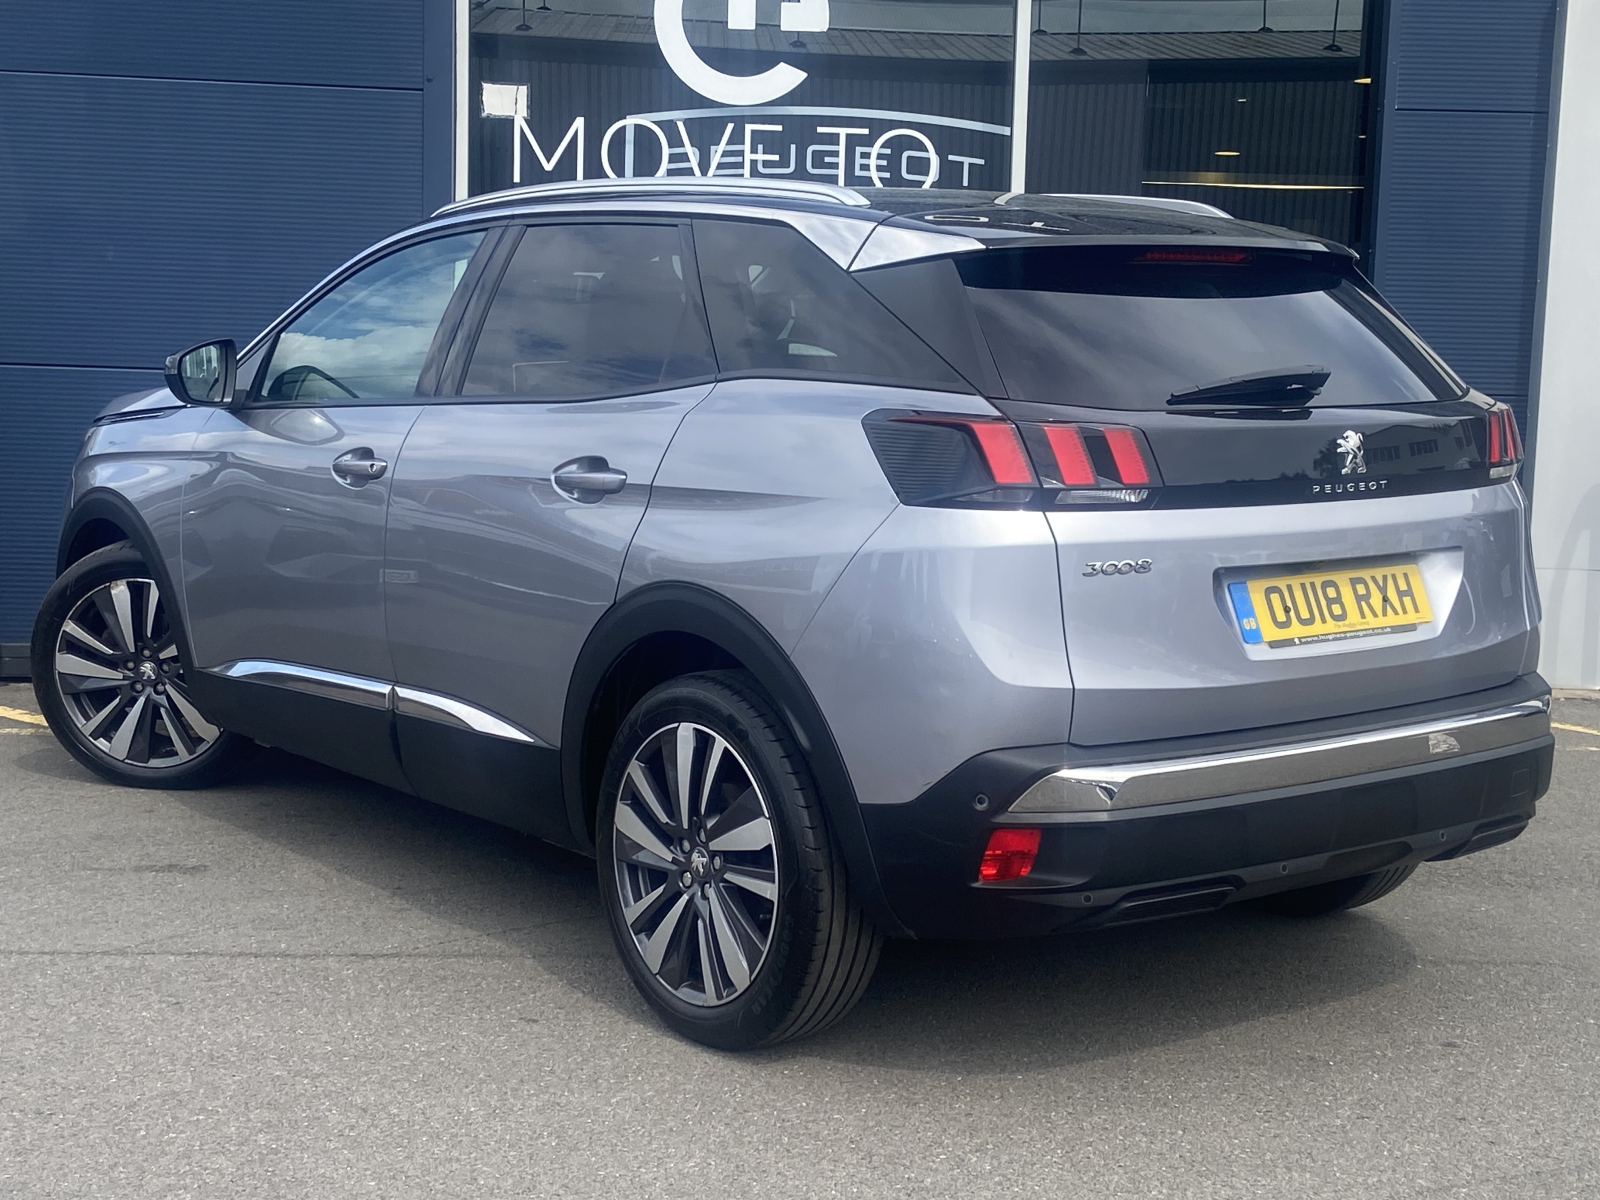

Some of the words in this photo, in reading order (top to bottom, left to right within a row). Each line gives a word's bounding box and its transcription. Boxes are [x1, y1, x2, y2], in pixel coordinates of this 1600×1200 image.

[816, 126, 938, 189] TO
[1312, 480, 1388, 494] PEUGEOT
[1082, 558, 1153, 577] 3008
[1264, 579, 1348, 630] OU18
[1348, 572, 1421, 620] RXH
